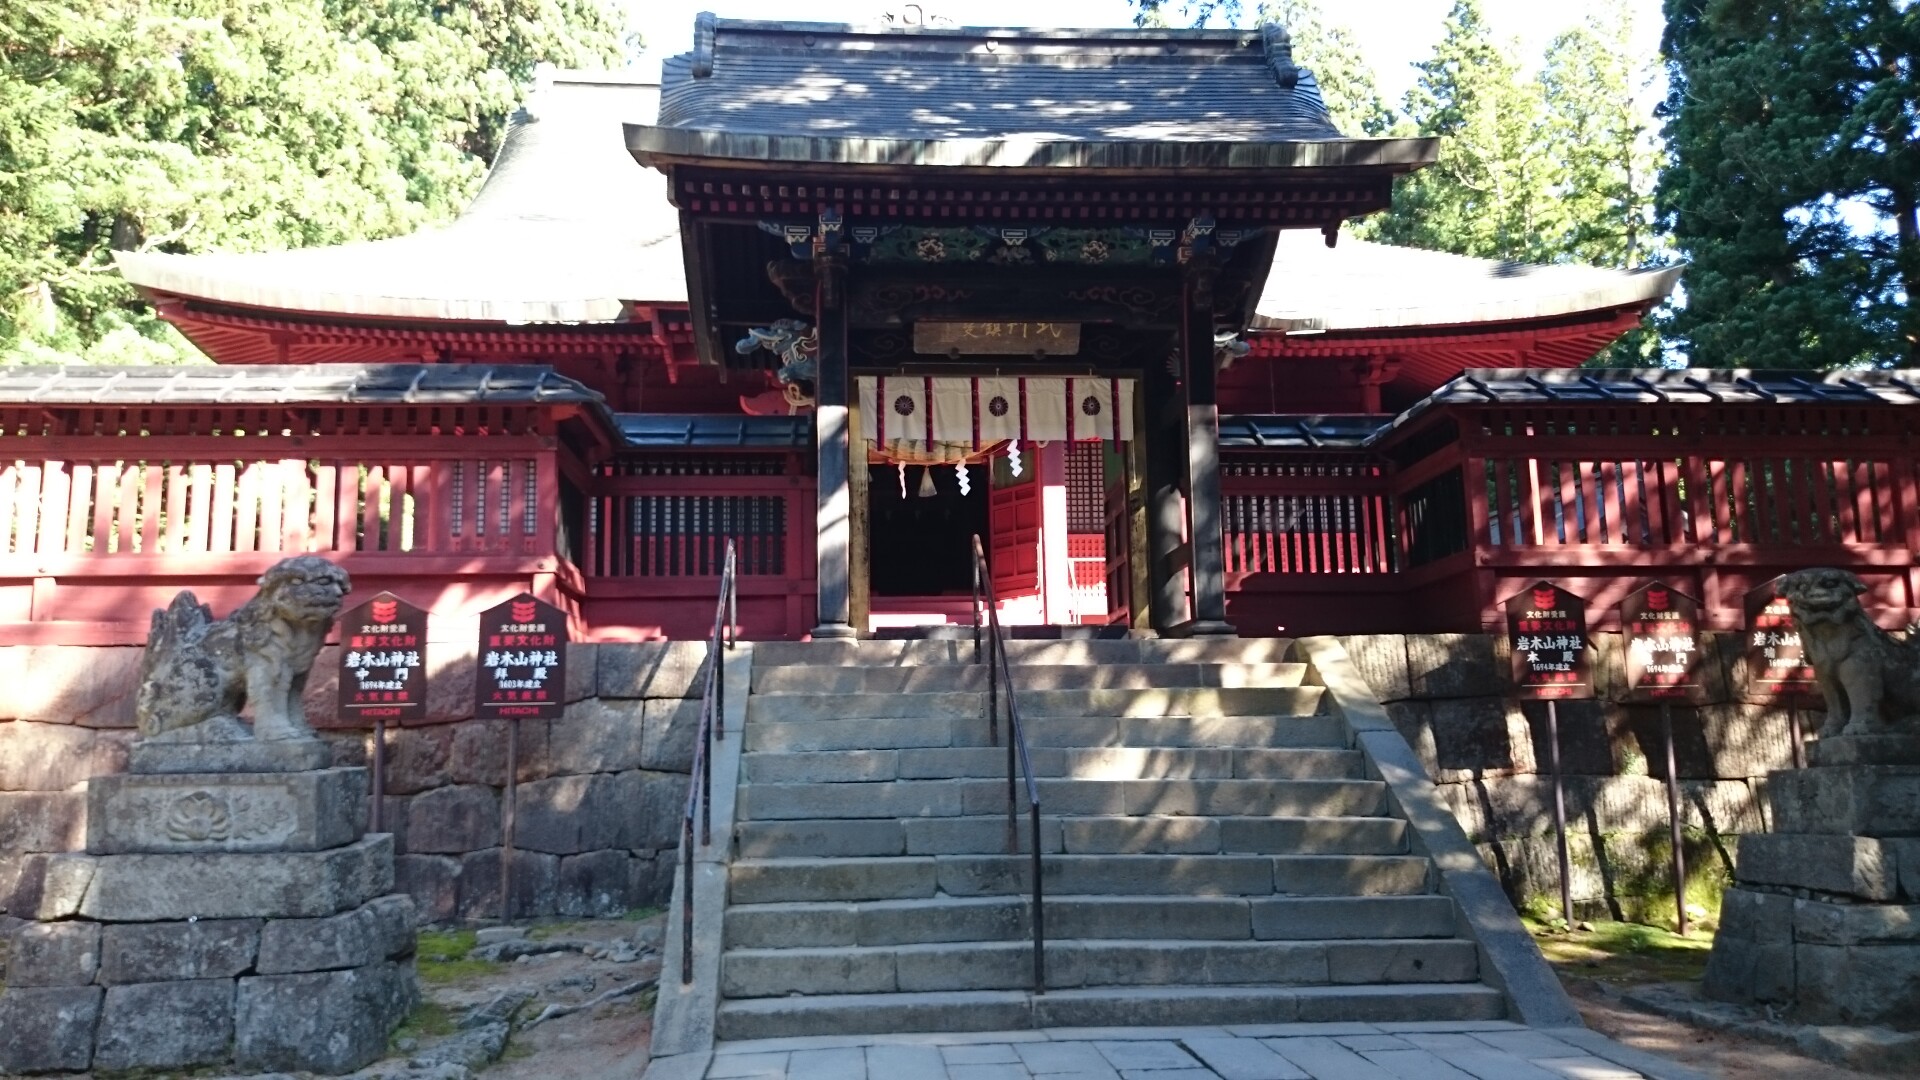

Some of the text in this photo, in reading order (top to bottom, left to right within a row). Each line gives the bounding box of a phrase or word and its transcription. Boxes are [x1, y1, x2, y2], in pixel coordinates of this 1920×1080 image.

[1526, 610, 1567, 618] 文化財愛護
[1640, 611, 1680, 619] 文化財愛護
[362, 624, 407, 633] 文化財愛護
[501, 624, 546, 633] 文化財愛護
[1518, 620, 1577, 631] 重要文化財
[351, 635, 417, 647] 重要文化財
[489, 635, 556, 647] 重要文化財
[1516, 635, 1583, 650] 岩木山神社
[1631, 636, 1696, 652] 岩木山神社
[345, 651, 420, 667] 岩木山神社
[484, 650, 559, 667] 岩木山神社
[1532, 663, 1571, 671] 1694年建立
[360, 680, 403, 690] 1694年建立
[499, 679, 542, 689] 1603年建立
[1536, 687, 1573, 696] HITACHI
[499, 707, 539, 715] HITACHI
